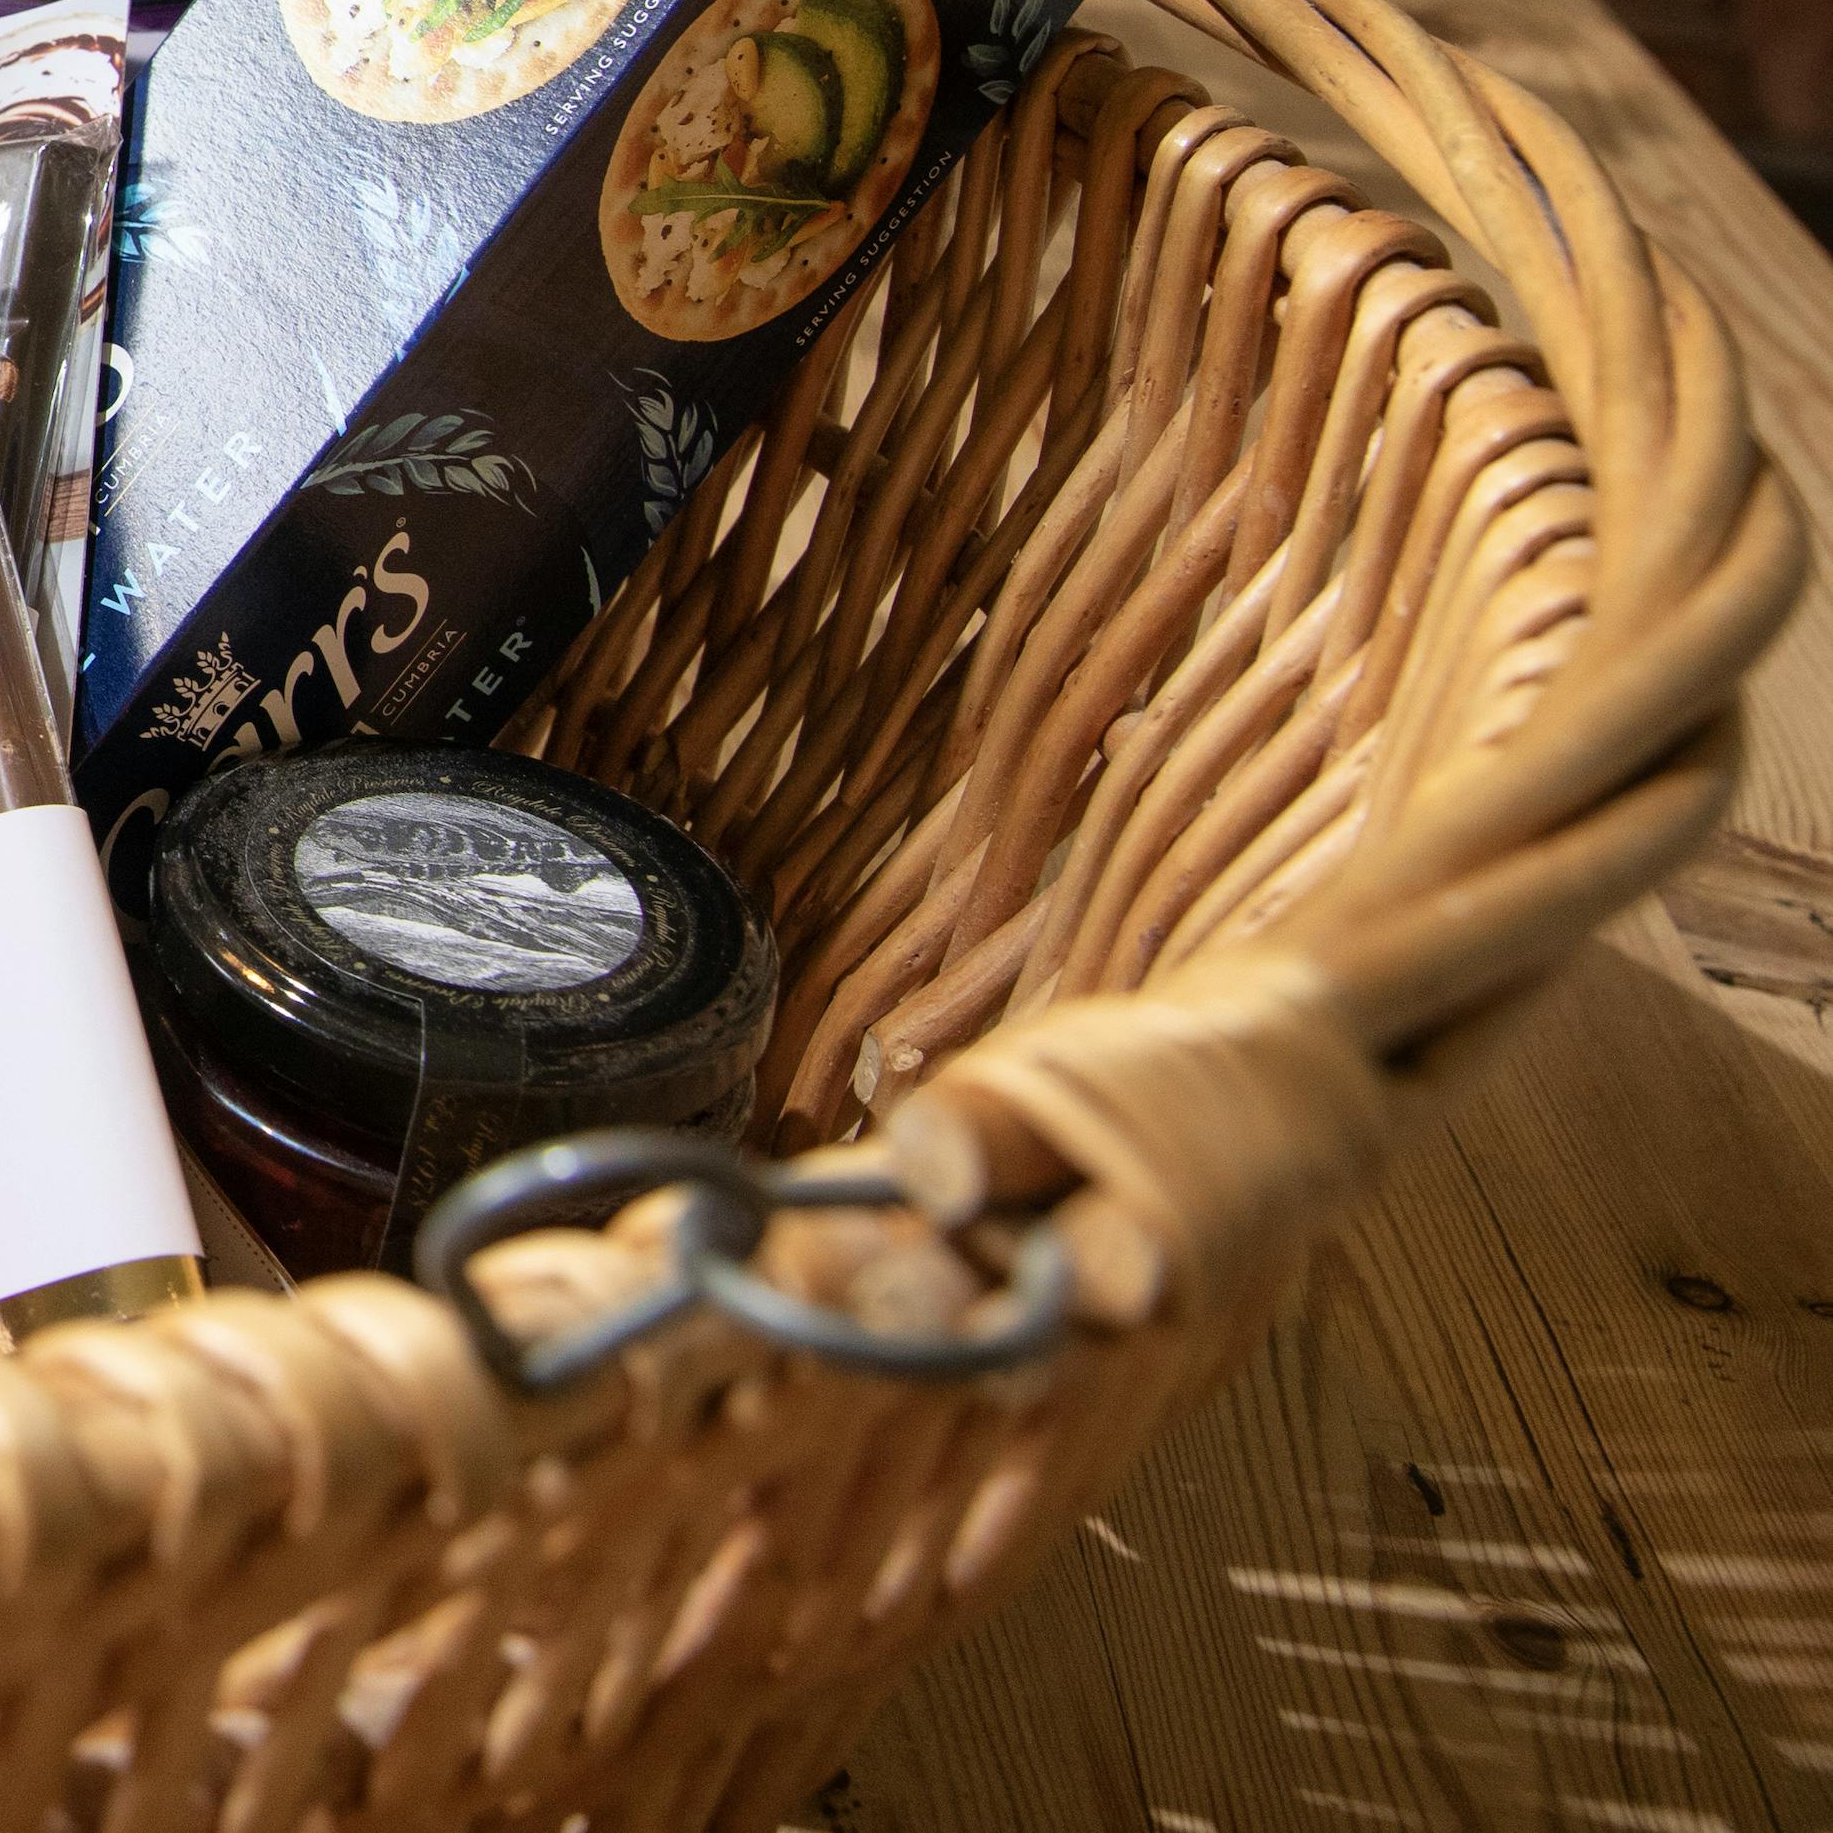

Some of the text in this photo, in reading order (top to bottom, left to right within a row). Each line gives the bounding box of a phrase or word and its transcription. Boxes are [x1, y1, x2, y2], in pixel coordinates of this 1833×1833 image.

[545, 54, 613, 135] SERVING
[795, 150, 953, 347] SERVING SUGGESTION
[94, 413, 168, 505] CUMBRIA
[99, 430, 263, 617] WATER
[382, 629, 459, 717] CUMBRIA
